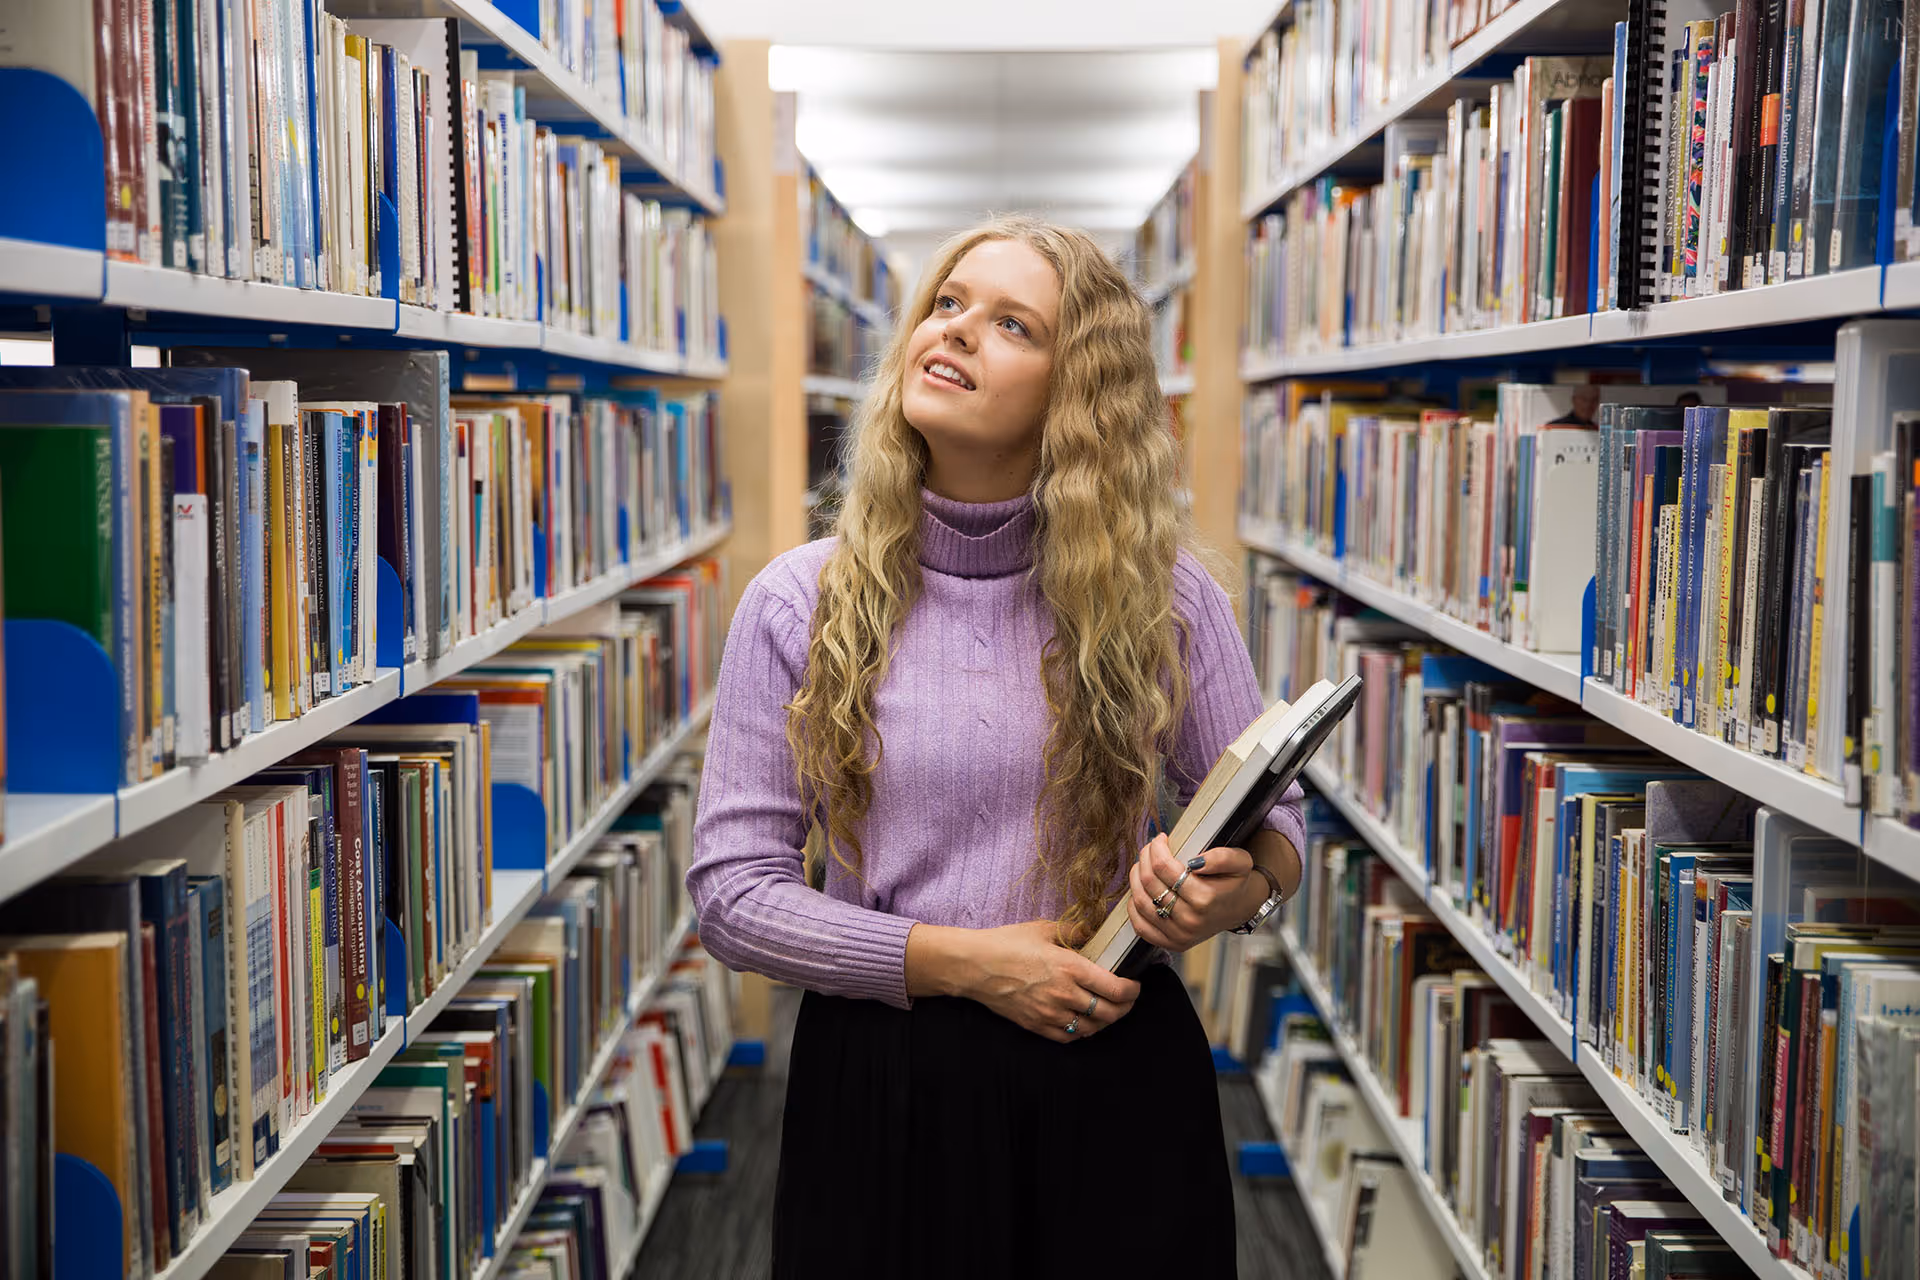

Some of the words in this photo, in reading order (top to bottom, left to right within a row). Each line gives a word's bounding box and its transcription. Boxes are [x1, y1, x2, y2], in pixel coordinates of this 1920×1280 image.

[1666, 99, 1679, 219] CONVERSATIONS
[1779, 113, 1792, 206] Psychodynamic
[1665, 221, 1673, 237] IN
[304, 434, 312, 505] BUSINESS
[312, 432, 321, 505] FUNDAMENTALS
[1691, 448, 1699, 491] HEART
[1725, 459, 1734, 490] The
[214, 501, 225, 569] FINANCE
[307, 508, 316, 580] FINANCE
[315, 518, 324, 571] CORPORATE
[352, 488, 360, 547] managing
[1689, 503, 1697, 534] SOUL
[1722, 495, 1731, 541] Heart
[318, 573, 326, 612] FINANCE
[1686, 551, 1694, 603] CHANGE
[1719, 564, 1729, 600] Soul
[328, 816, 336, 849] COST
[354, 837, 363, 875] Cost
[329, 851, 338, 938] ACCOUNTING
[348, 869, 357, 927] Managerial
[351, 928, 359, 977] Emphasis
[356, 880, 366, 975] Accounting
[1658, 905, 1668, 1009] CONSTRUCTIVE
[1775, 1035, 1787, 1102] Narrative
